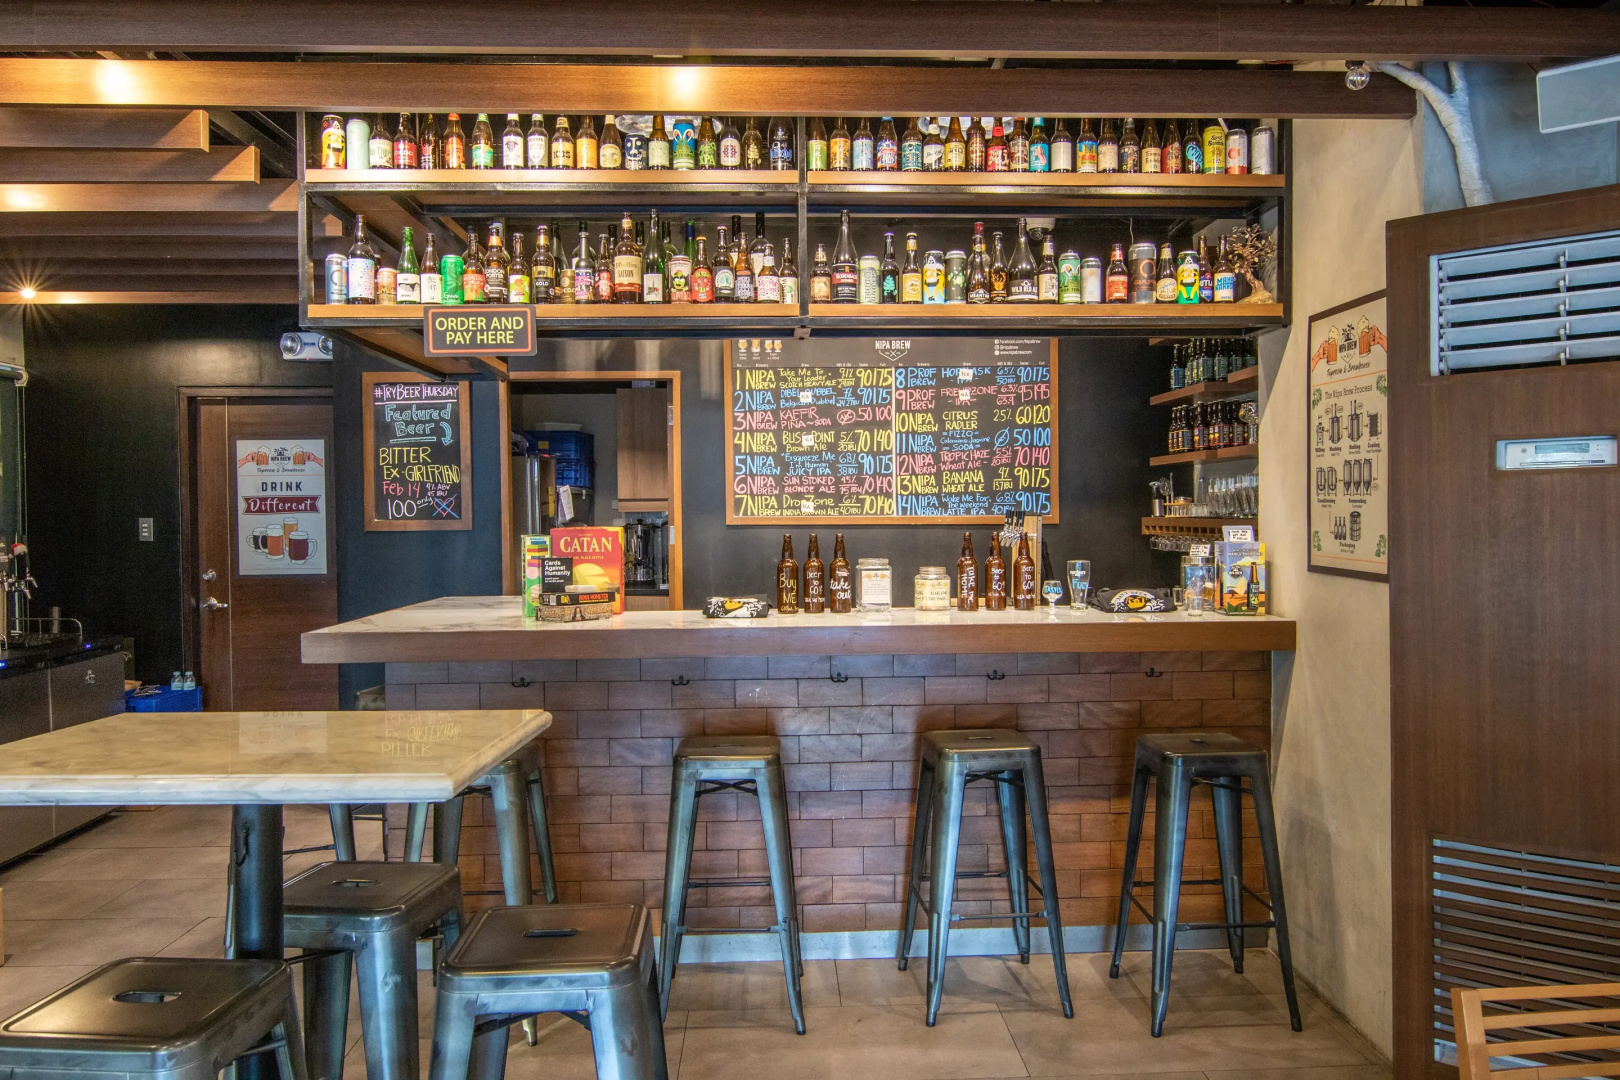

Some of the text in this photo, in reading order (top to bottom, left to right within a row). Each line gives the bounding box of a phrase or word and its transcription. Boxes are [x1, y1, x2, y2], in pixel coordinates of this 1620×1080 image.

[436, 317, 523, 330] ORDER AND
[446, 331, 514, 344] PAY HERE
[875, 340, 911, 349] NIPA BREW
[736, 370, 740, 390] 1
[746, 370, 775, 389] NIPA
[778, 368, 795, 376] Take
[799, 368, 810, 376] Me
[856, 368, 872, 387] 90
[873, 368, 892, 386] 175
[896, 368, 905, 388] 8
[908, 368, 936, 387] PROF
[1017, 367, 1031, 383] 90
[1033, 367, 1050, 381] 175
[911, 378, 936, 386] BREW
[746, 390, 774, 410] NIPA
[858, 388, 872, 405] 90
[873, 388, 891, 405] 175
[896, 390, 906, 410] 9
[907, 389, 936, 410] PROF
[1018, 385, 1033, 403] 95
[1035, 383, 1050, 400] 195
[734, 391, 744, 412] 2
[757, 403, 776, 411] BREW
[911, 400, 935, 410] BREW
[384, 403, 451, 422] Featured
[734, 413, 744, 430] 3
[746, 411, 773, 430] NIPA
[780, 407, 819, 420] KAFFIR
[857, 407, 872, 421] 50
[876, 406, 892, 421] 100
[943, 411, 978, 420] CITRUS
[1016, 406, 1031, 424] 60
[1034, 404, 1050, 424] 120
[395, 422, 434, 437] Beer
[757, 422, 777, 430] BREW
[896, 413, 908, 432] 10
[909, 413, 933, 432] NIPA
[946, 421, 978, 430] RADLER
[734, 432, 744, 452] 4
[747, 432, 776, 452] NIPA
[812, 431, 835, 442] POINT
[855, 430, 870, 452] 70
[874, 429, 892, 451] 140
[897, 434, 905, 454] 11
[909, 434, 934, 453] NIPA
[1014, 429, 1031, 446] 50
[1034, 427, 1051, 446] 100
[380, 447, 431, 465] BITTER
[787, 443, 827, 452] Brown Ale
[823, 451, 836, 460] Me
[940, 450, 990, 462] TROPIC HAZE
[1014, 447, 1030, 466] 70
[1032, 447, 1050, 466] 140
[735, 456, 746, 475] 5
[746, 456, 774, 474] NIPA
[787, 468, 812, 476] JUICY
[858, 453, 874, 474] 90
[877, 455, 893, 473] 175
[897, 455, 909, 475] 12
[909, 454, 933, 474] NIPA
[918, 466, 936, 474] BREW
[968, 459, 981, 468] Ale
[734, 476, 746, 494] 6
[748, 476, 775, 494] NIPA
[782, 476, 835, 485] SUN STOKED
[861, 476, 874, 494] 70
[876, 475, 893, 494] 140
[897, 476, 912, 495] 13
[912, 475, 936, 494] NIPA
[943, 470, 984, 484] BANANA
[1015, 467, 1029, 489] 90
[1032, 467, 1050, 488] 175
[262, 482, 302, 492] DRINK
[382, 481, 420, 498] Feb 14
[942, 484, 985, 493] WHEAT ALE
[248, 498, 315, 512] Different
[735, 495, 747, 516] 7
[748, 495, 778, 516] NIPA
[859, 495, 876, 514] 70
[878, 495, 893, 514] 140
[898, 496, 910, 516] 14
[912, 495, 938, 516] NIPA
[962, 494, 973, 502] Me
[1016, 491, 1032, 512] 90
[1033, 492, 1050, 513] 175
[388, 496, 433, 519] 100 only
[922, 507, 941, 515] BREW
[943, 508, 966, 516] LATTE
[560, 536, 612, 552] CATAN
[780, 573, 796, 592] Buy
[830, 578, 850, 590] take
[783, 592, 796, 604] ME
[837, 591, 851, 599] out
